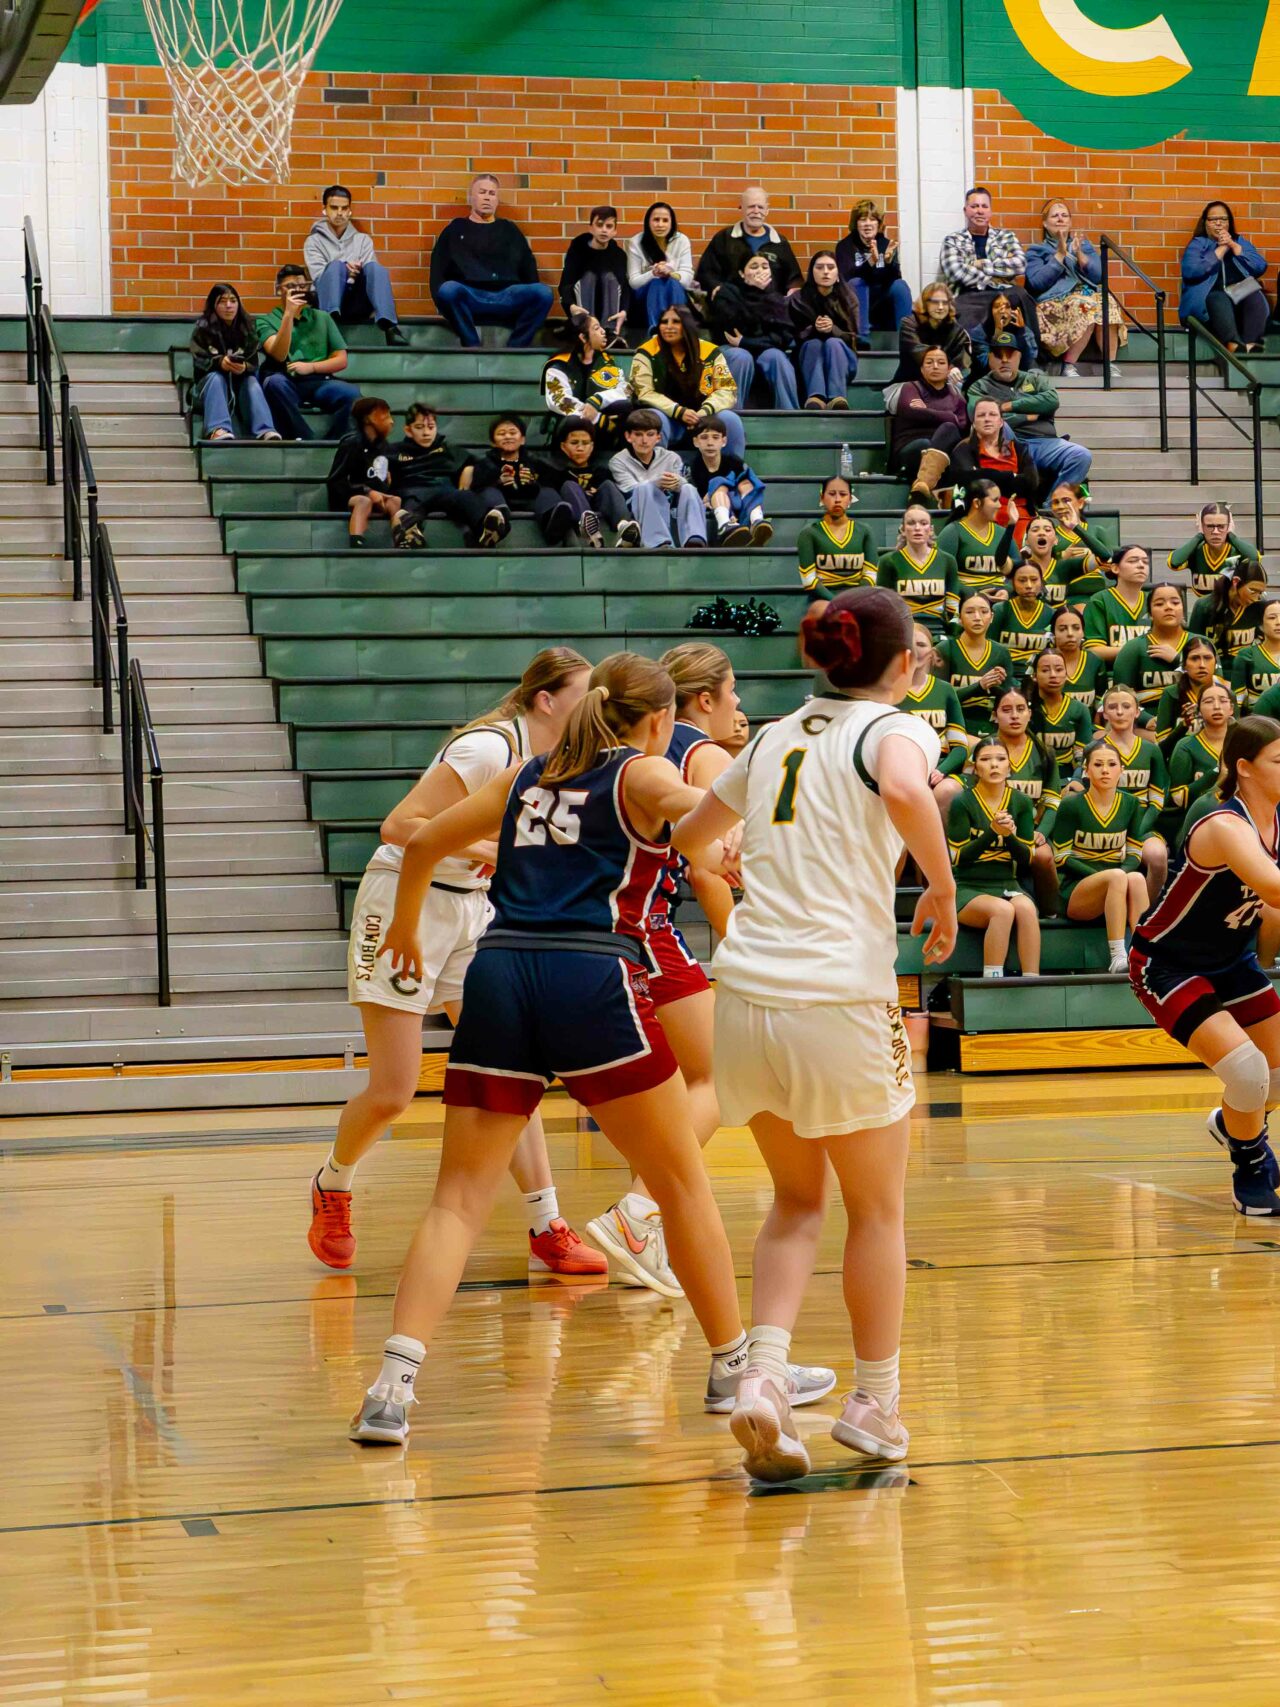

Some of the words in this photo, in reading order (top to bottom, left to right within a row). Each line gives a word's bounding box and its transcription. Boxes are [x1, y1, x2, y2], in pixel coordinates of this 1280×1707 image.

[514, 787, 592, 848] 25
[772, 748, 808, 824] 1
[355, 915, 381, 981] COWBOYS
